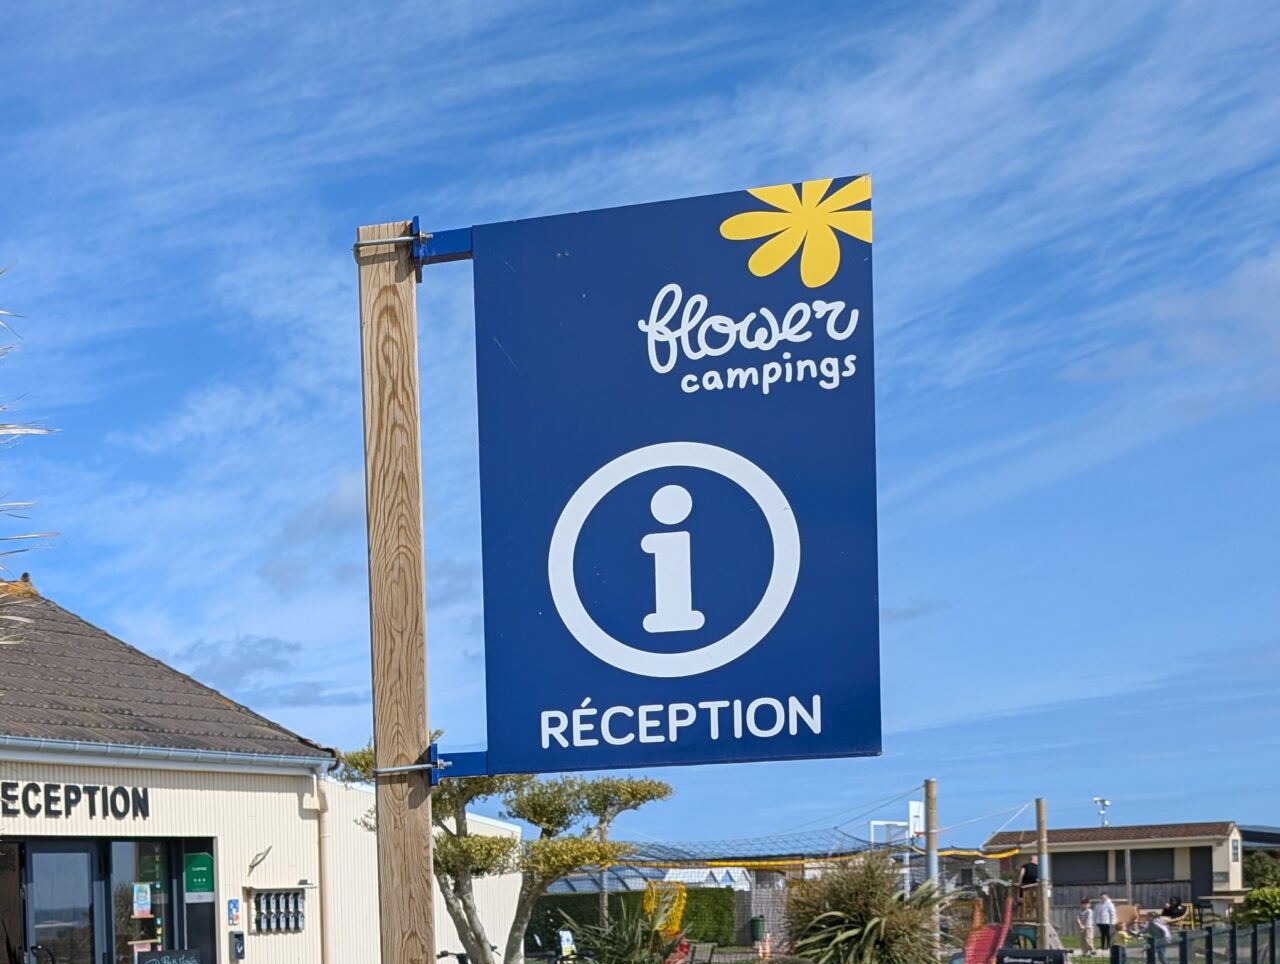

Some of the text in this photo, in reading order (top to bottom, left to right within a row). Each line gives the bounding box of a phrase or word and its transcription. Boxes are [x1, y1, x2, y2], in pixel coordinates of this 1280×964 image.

[638, 283, 860, 374] flower
[680, 351, 858, 395] campings
[540, 694, 822, 749] RÉCEPTION
